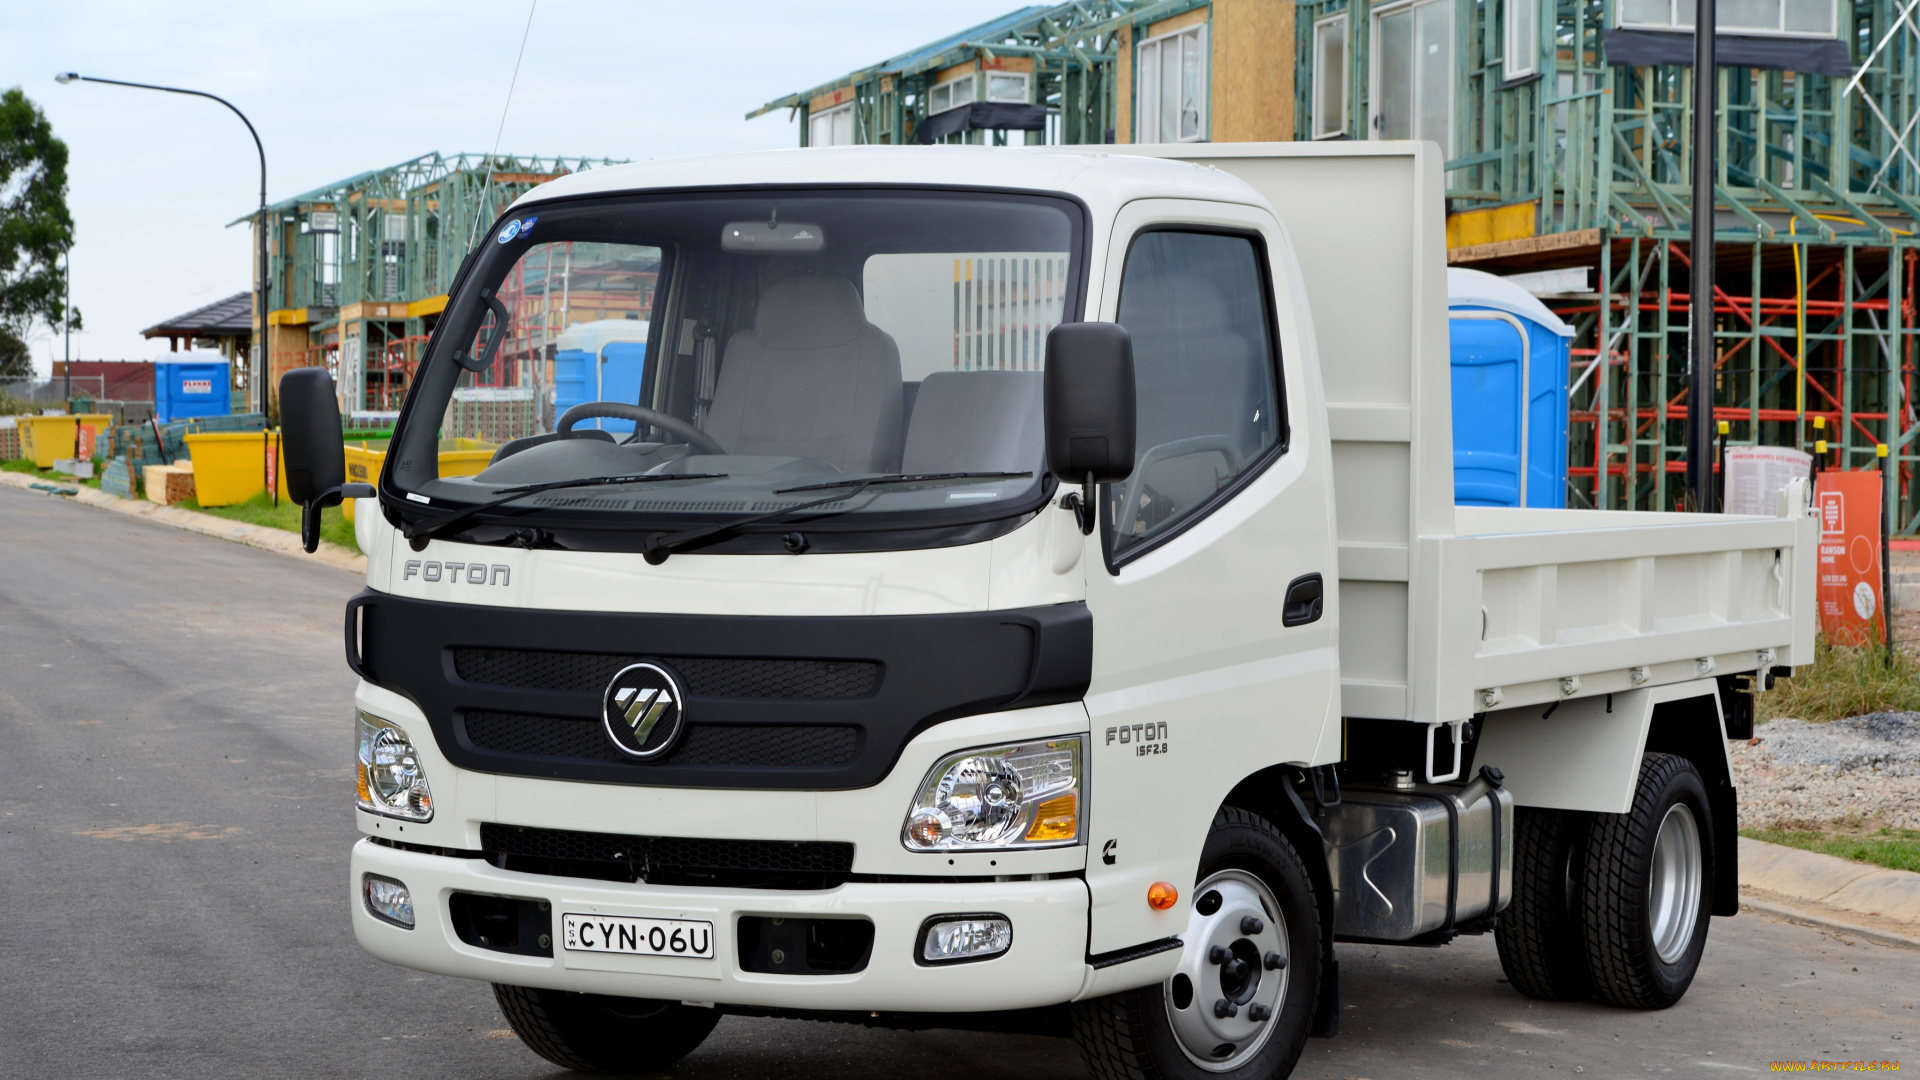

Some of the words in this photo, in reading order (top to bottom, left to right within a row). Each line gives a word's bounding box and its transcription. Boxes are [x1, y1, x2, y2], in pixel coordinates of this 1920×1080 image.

[1821, 546, 1846, 555] RAWSON
[403, 559, 511, 587] FOTON
[1106, 721, 1168, 746] FOTON
